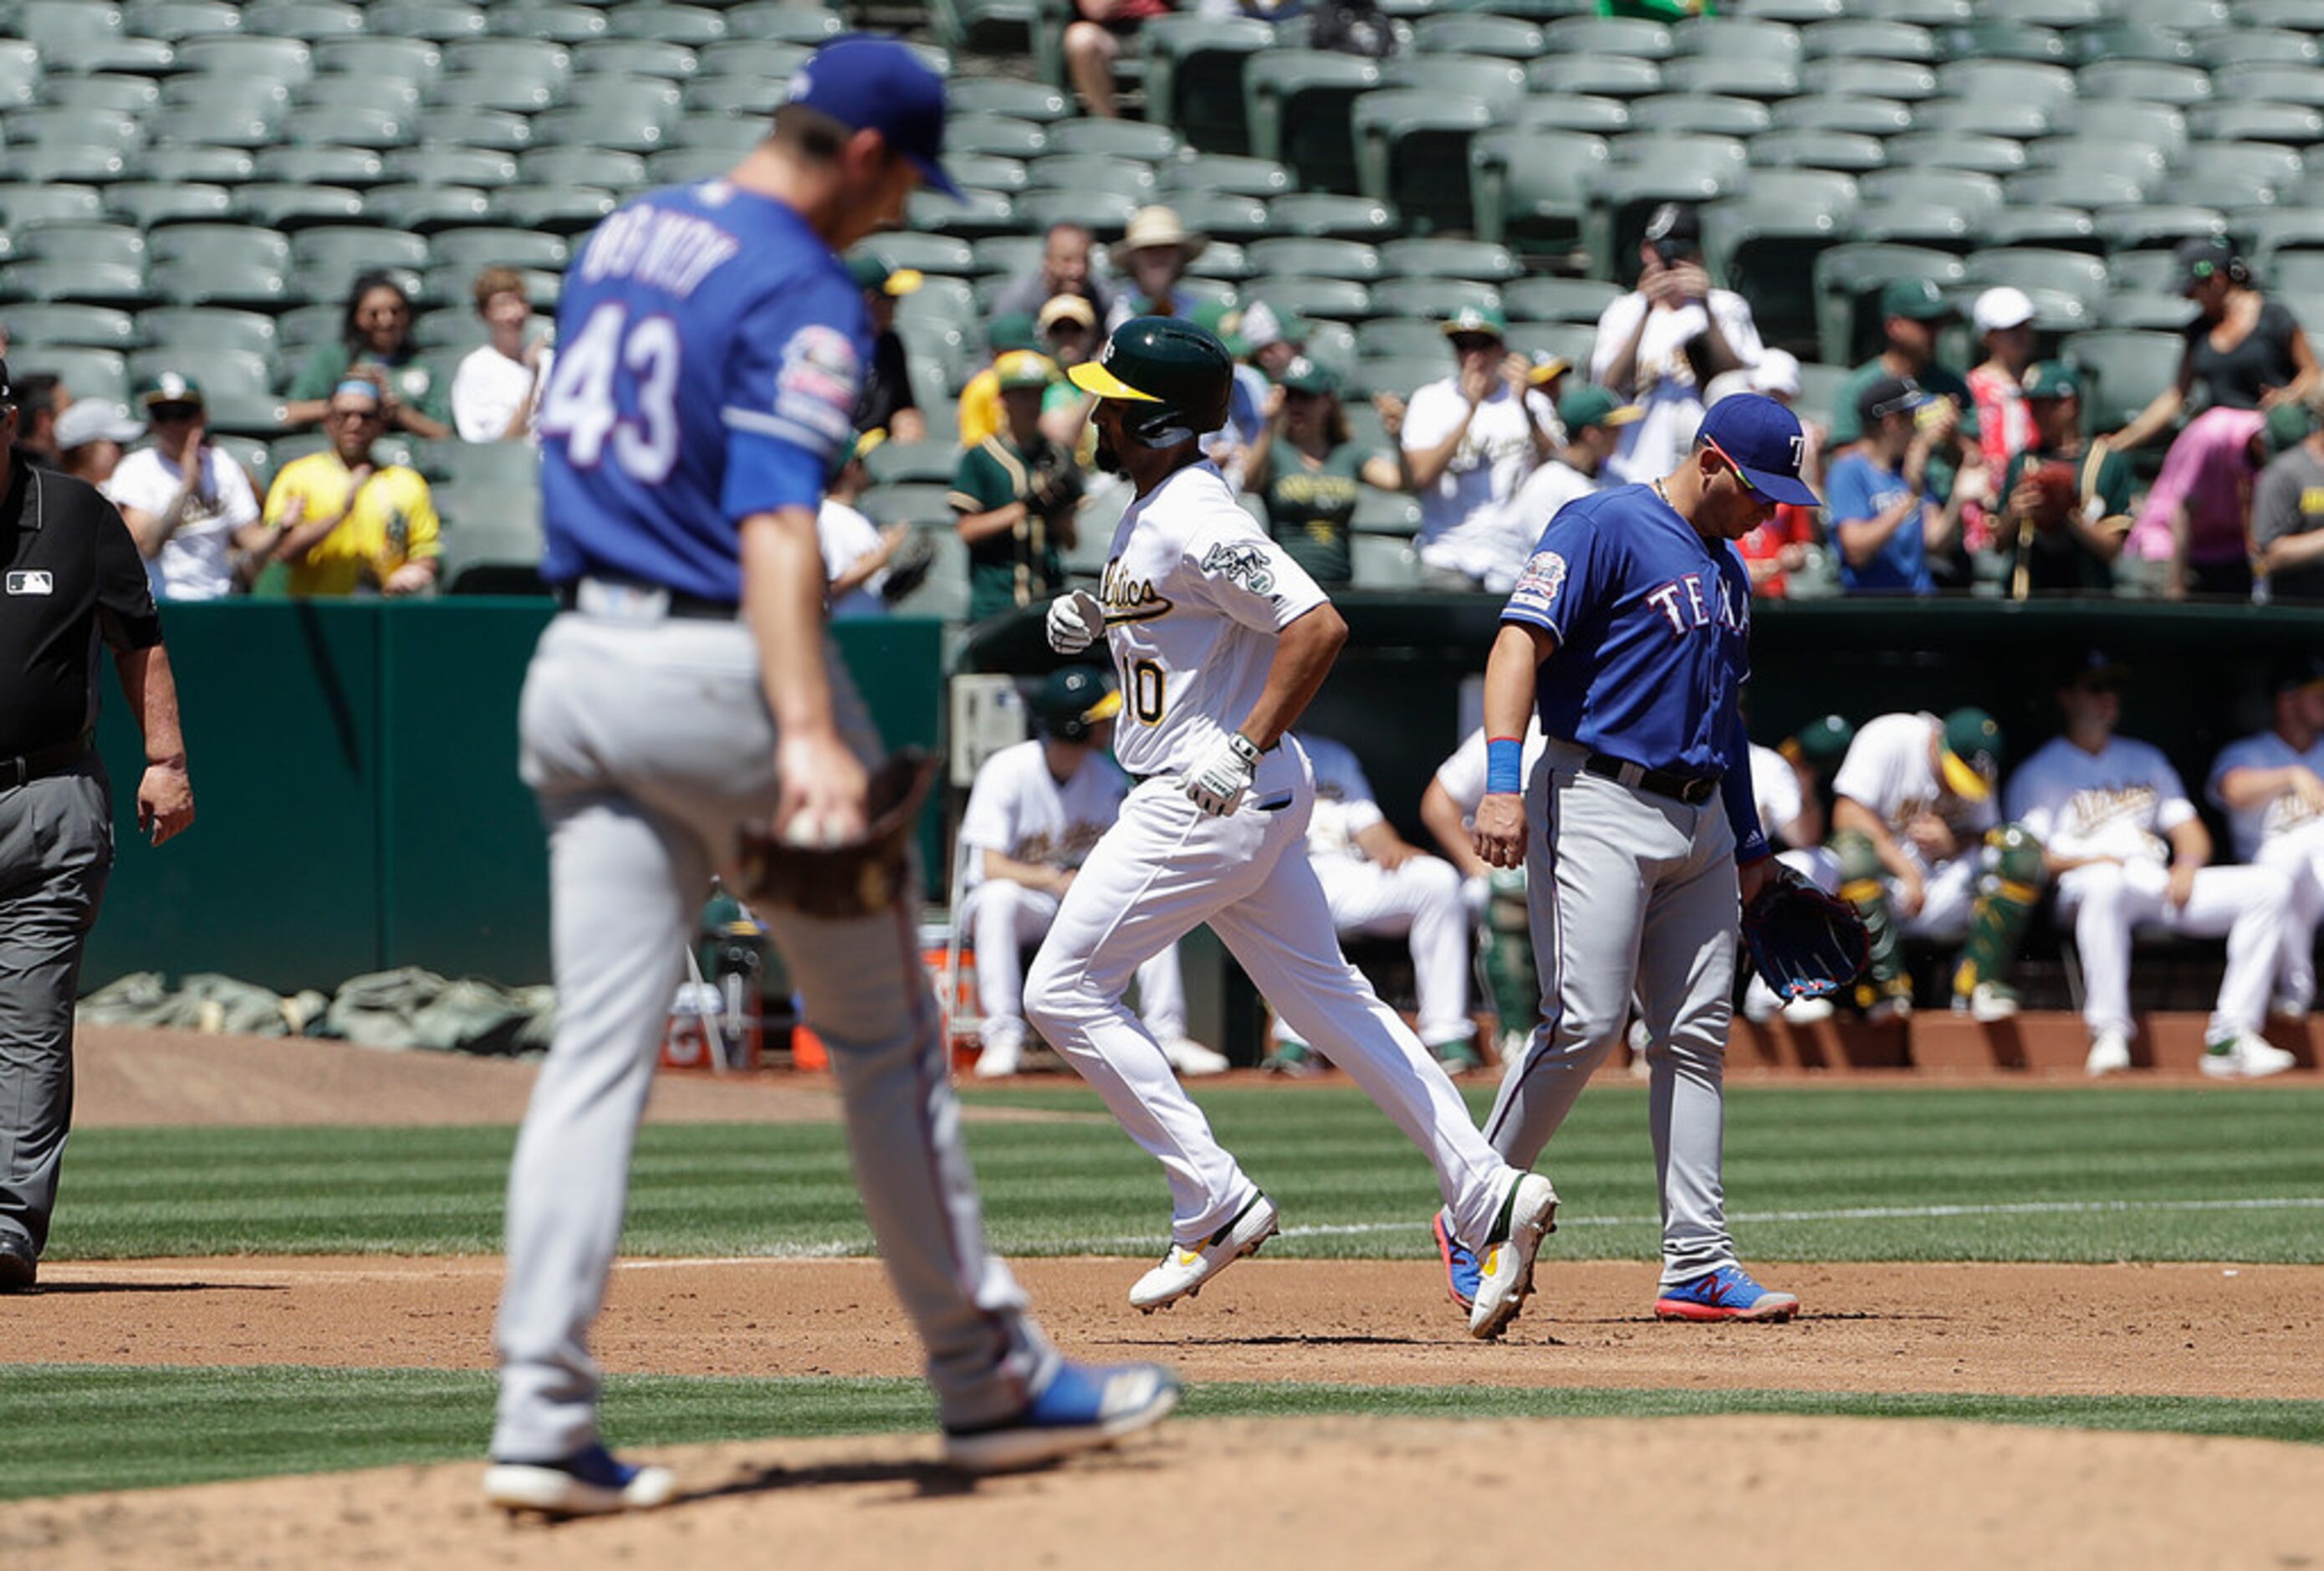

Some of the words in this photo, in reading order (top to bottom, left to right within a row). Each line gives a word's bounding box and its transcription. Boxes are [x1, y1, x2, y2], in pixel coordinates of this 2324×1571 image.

[540, 299, 681, 485] 43
[1122, 652, 1167, 728] 10
[1694, 1273, 1734, 1303] N
